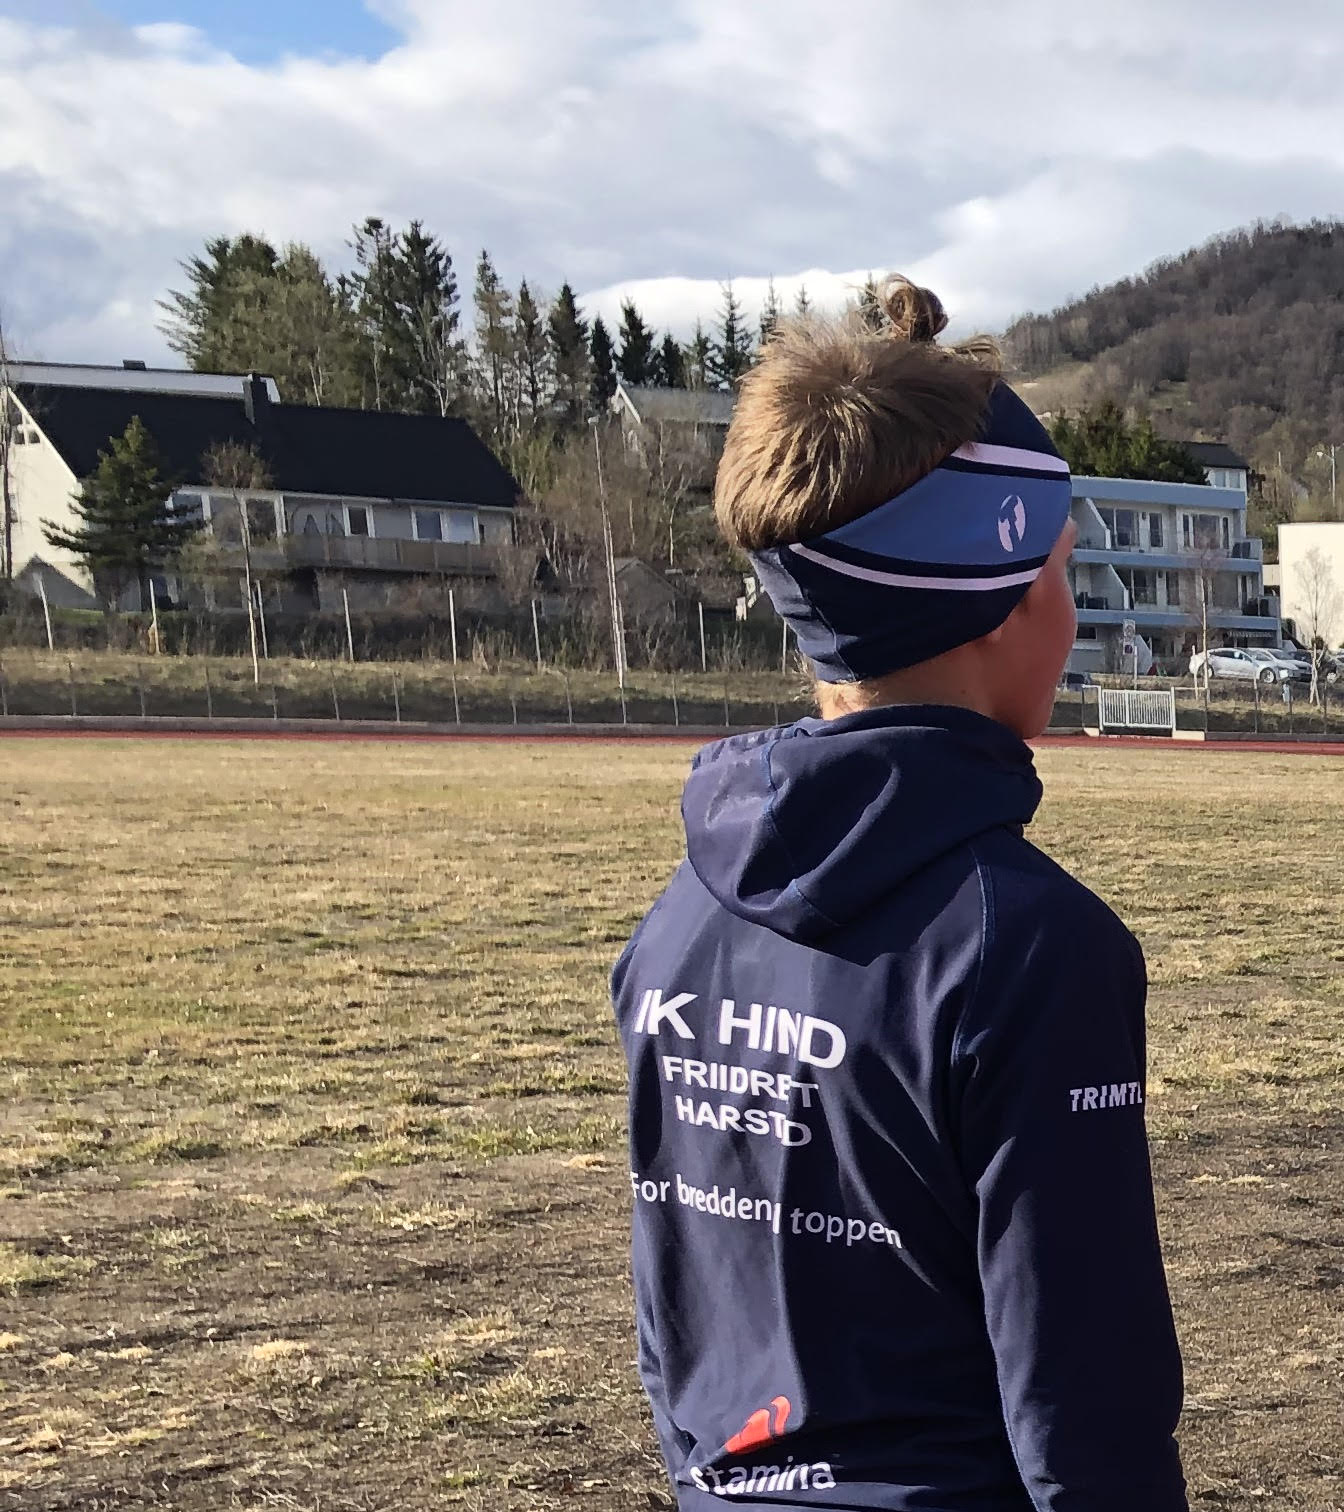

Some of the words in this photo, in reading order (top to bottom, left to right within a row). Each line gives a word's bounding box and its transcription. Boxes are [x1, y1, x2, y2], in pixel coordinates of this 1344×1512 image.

[634, 988, 698, 1040] IK
[718, 998, 847, 1069] HIND
[630, 1171, 670, 1202] For
[790, 1208, 902, 1248] toppen
